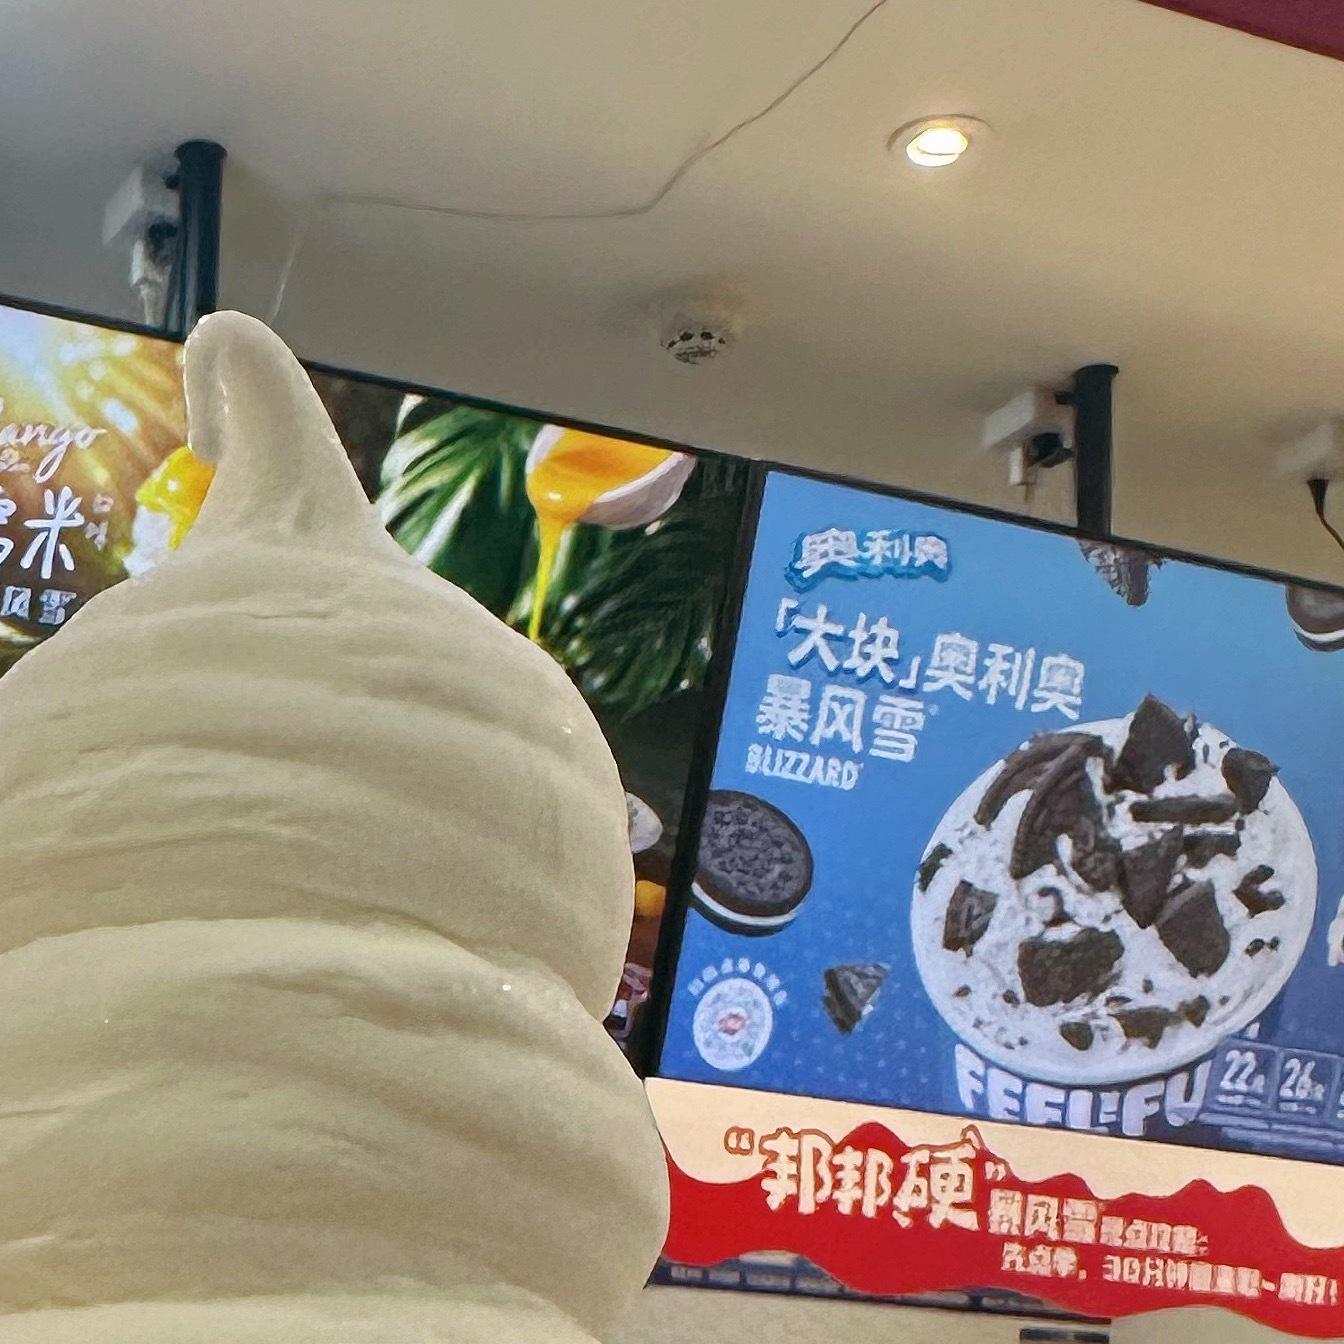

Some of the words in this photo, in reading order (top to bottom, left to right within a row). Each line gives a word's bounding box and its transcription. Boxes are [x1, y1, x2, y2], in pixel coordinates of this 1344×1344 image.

[756, 674, 926, 763] 暴风雪
[745, 743, 863, 791] BLIZZARD
